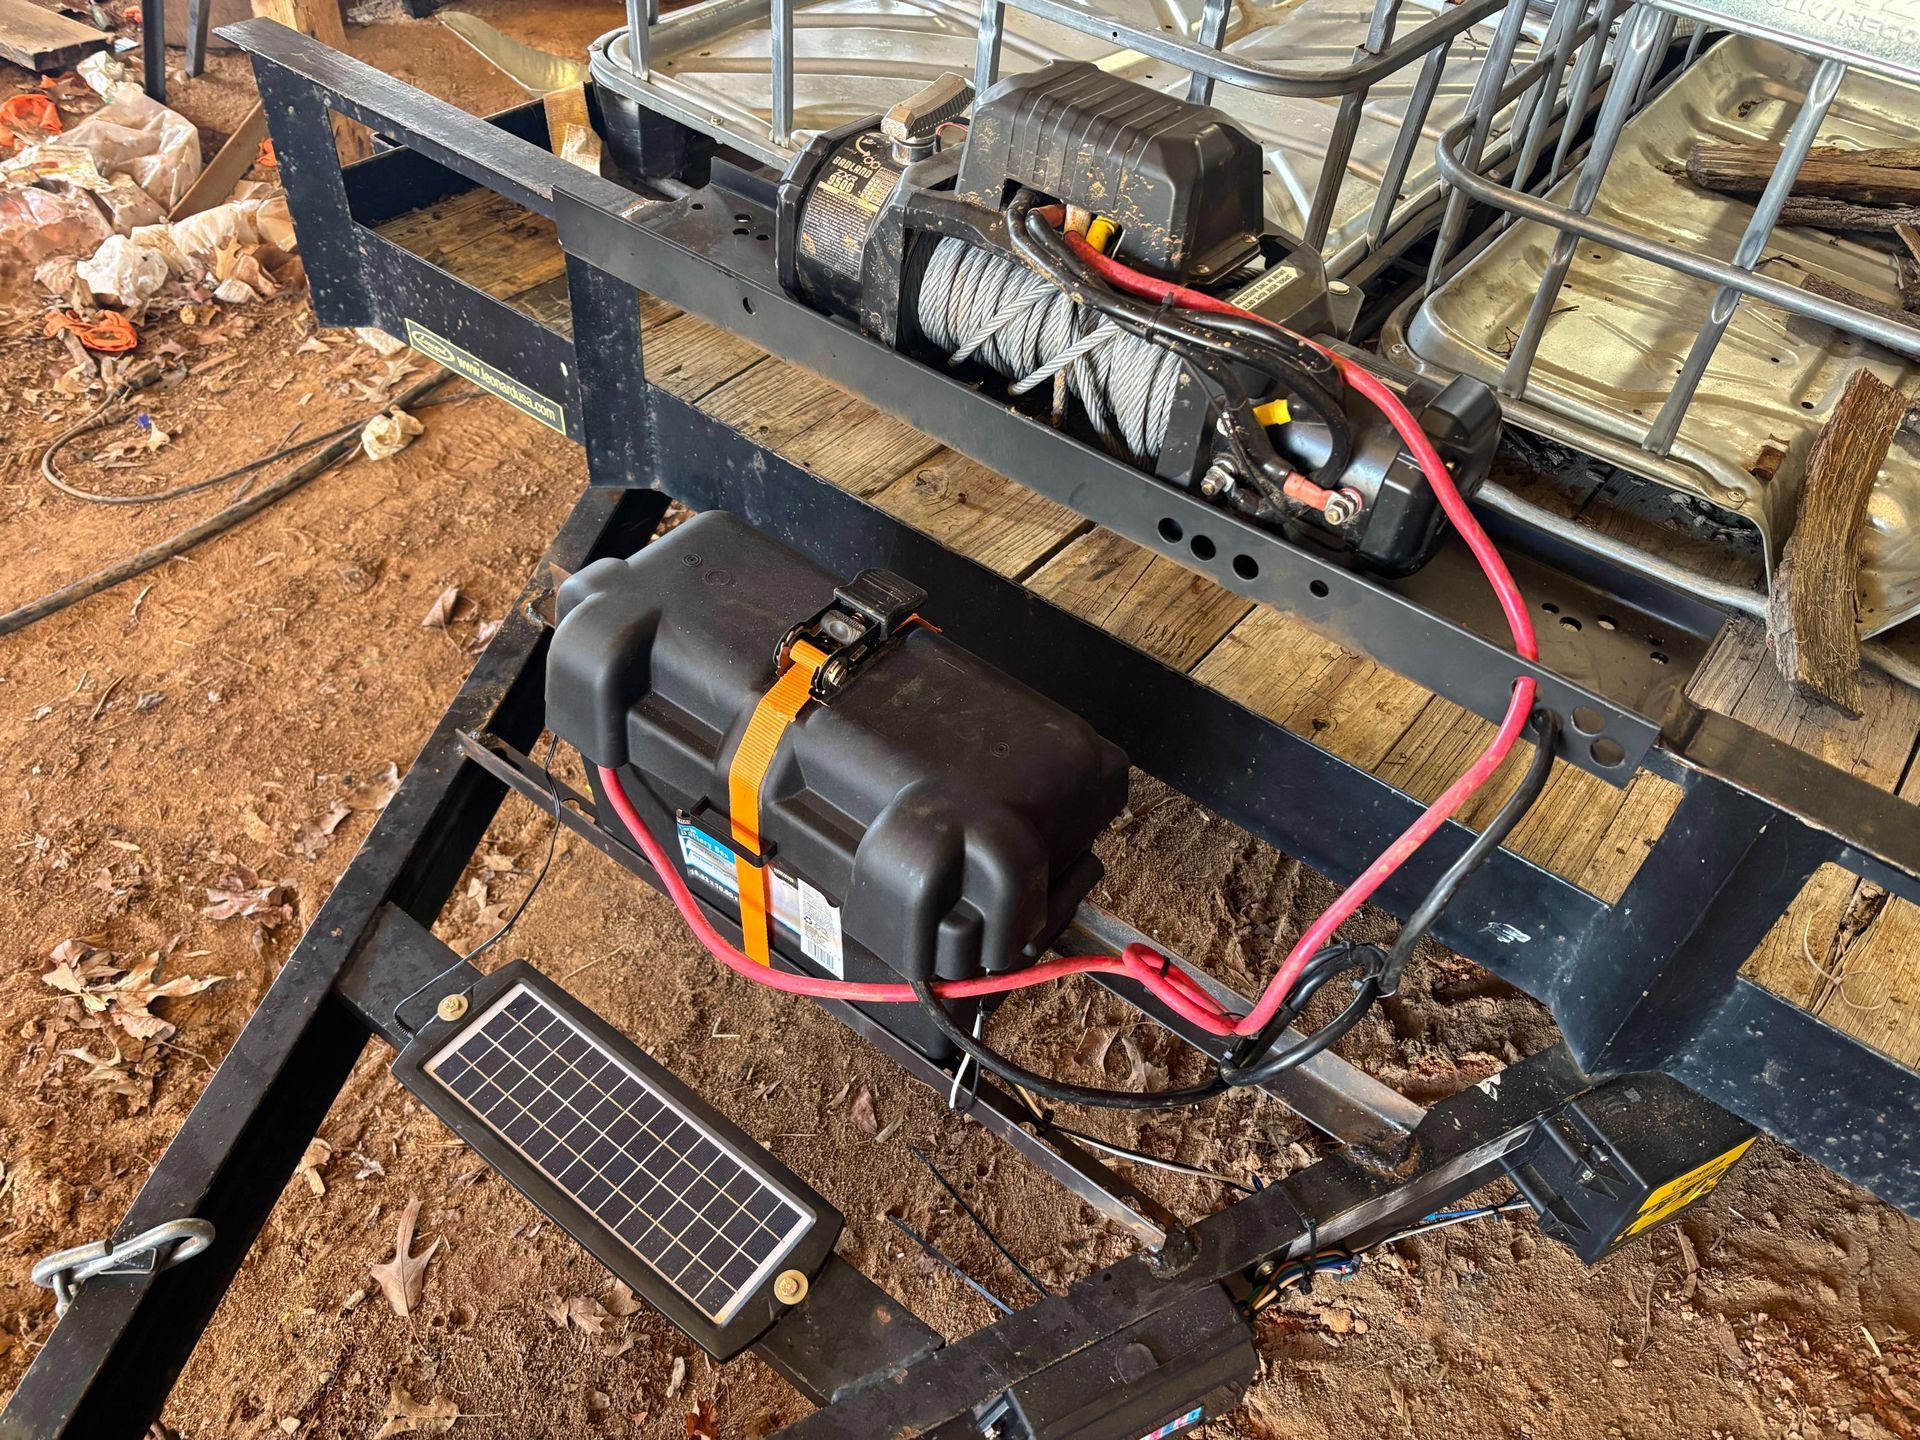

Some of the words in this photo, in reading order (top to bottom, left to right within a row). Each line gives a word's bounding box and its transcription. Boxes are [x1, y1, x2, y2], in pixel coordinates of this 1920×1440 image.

[832, 156, 873, 178] BADLAND
[834, 169, 858, 183] ZXR
[827, 175, 855, 193] 9500
[456, 356, 556, 422] www.leonardusa.com
[681, 828, 712, 850] Battery
[714, 844, 729, 859] Box
